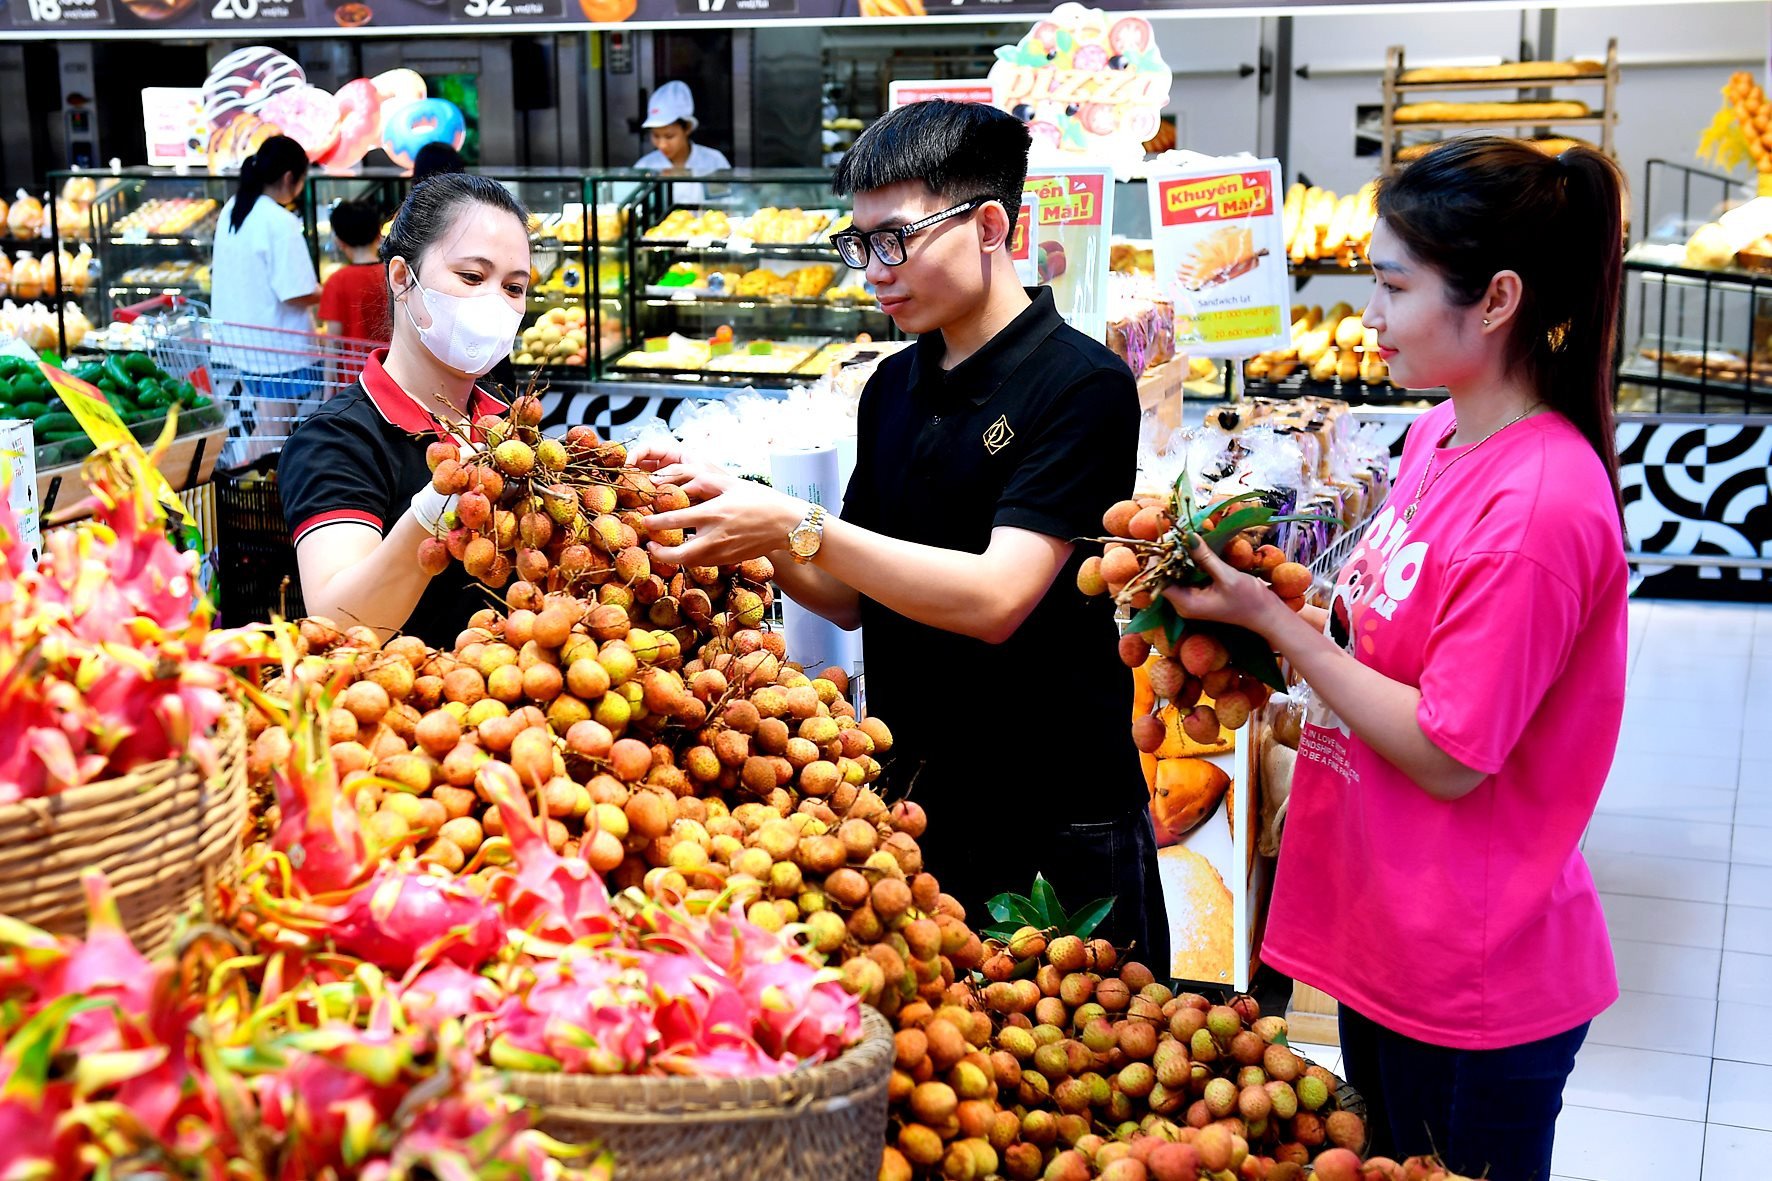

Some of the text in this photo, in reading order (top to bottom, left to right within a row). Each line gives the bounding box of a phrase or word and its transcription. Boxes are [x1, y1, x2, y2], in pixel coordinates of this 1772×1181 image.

[1171, 180, 1239, 206] Khuyến
[1317, 733, 1335, 747] LOVE
[1309, 751, 1321, 762] BE
